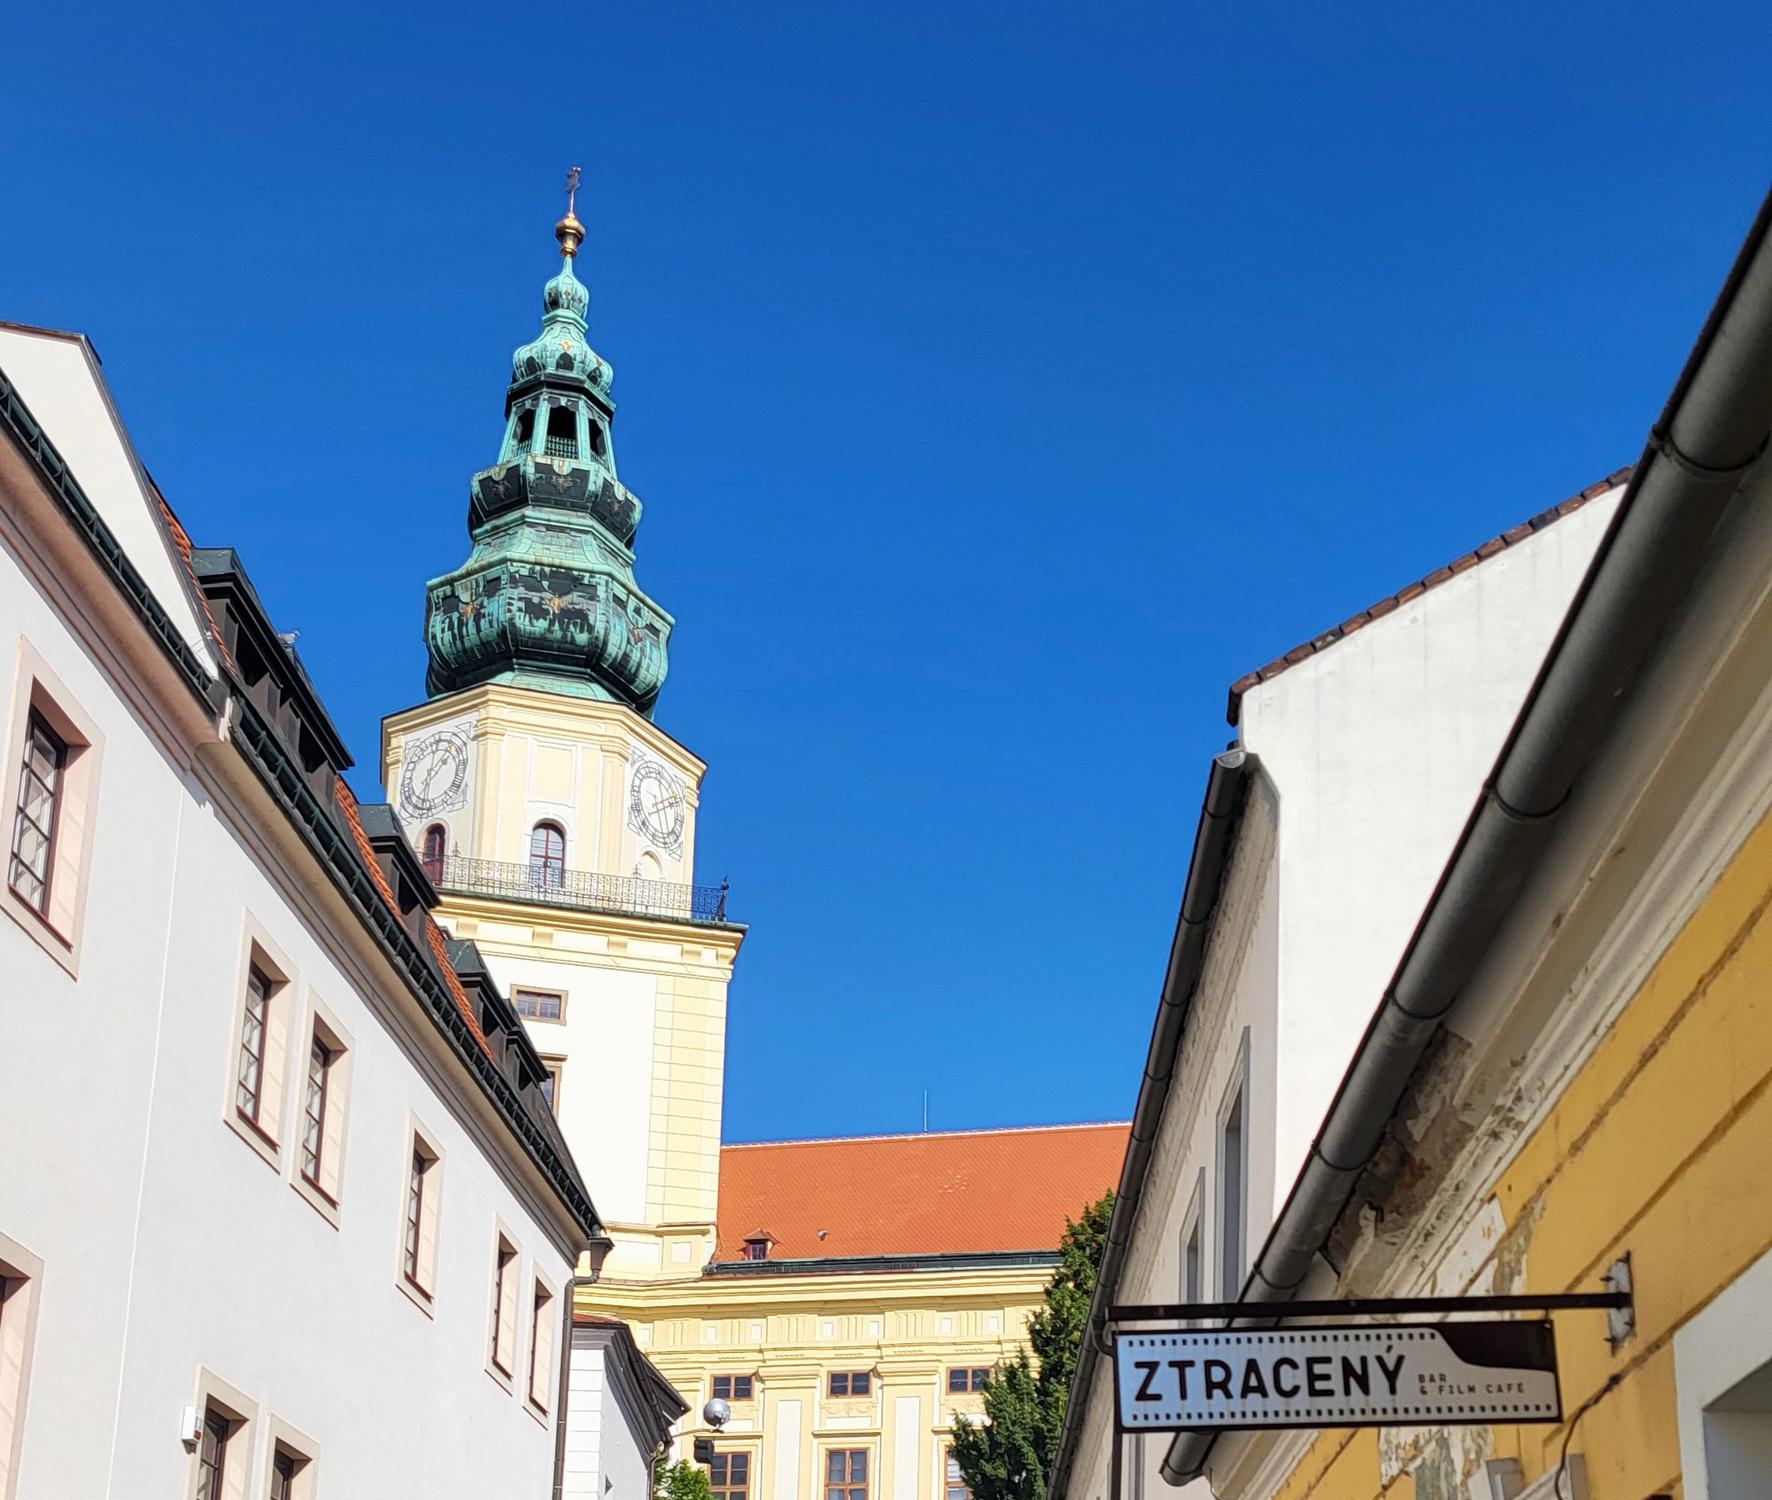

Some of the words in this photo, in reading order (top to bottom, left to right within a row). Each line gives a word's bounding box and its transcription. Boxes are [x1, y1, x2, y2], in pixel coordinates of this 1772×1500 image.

[1134, 1345, 1405, 1401] ZTRACENÝ
[1418, 1373, 1447, 1384] BAR
[1439, 1384, 1476, 1395] FILM
